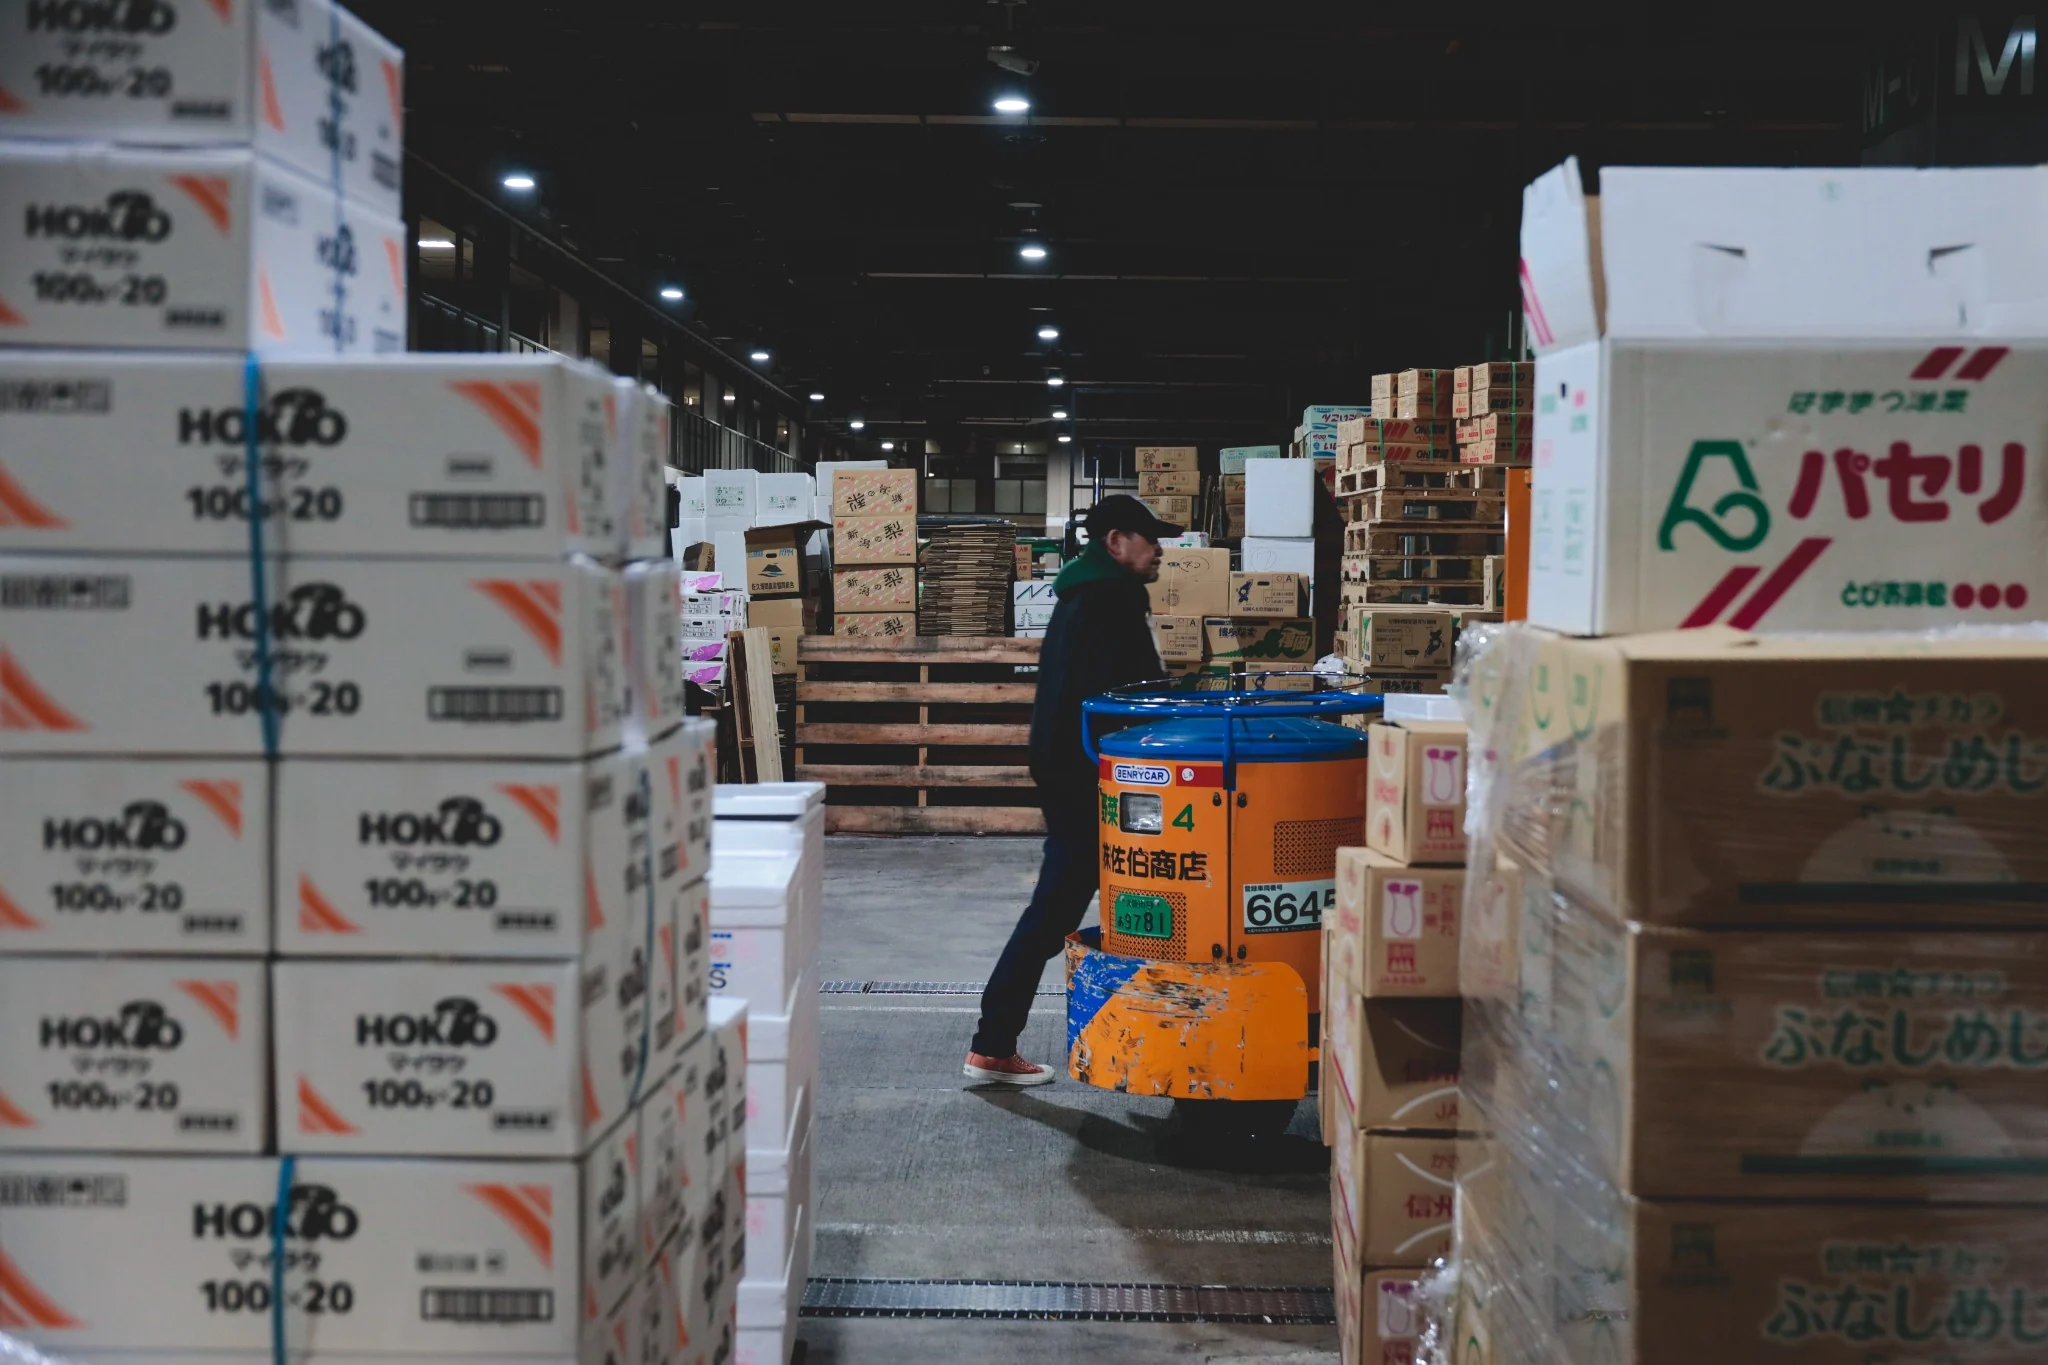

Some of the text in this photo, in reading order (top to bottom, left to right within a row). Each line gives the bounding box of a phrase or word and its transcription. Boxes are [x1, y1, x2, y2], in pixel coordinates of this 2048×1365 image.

[1955, 14, 2036, 95] M
[1788, 441, 2025, 525] パセリ
[1117, 768, 1164, 781] BENRYCAR
[1172, 803, 1195, 833] 4
